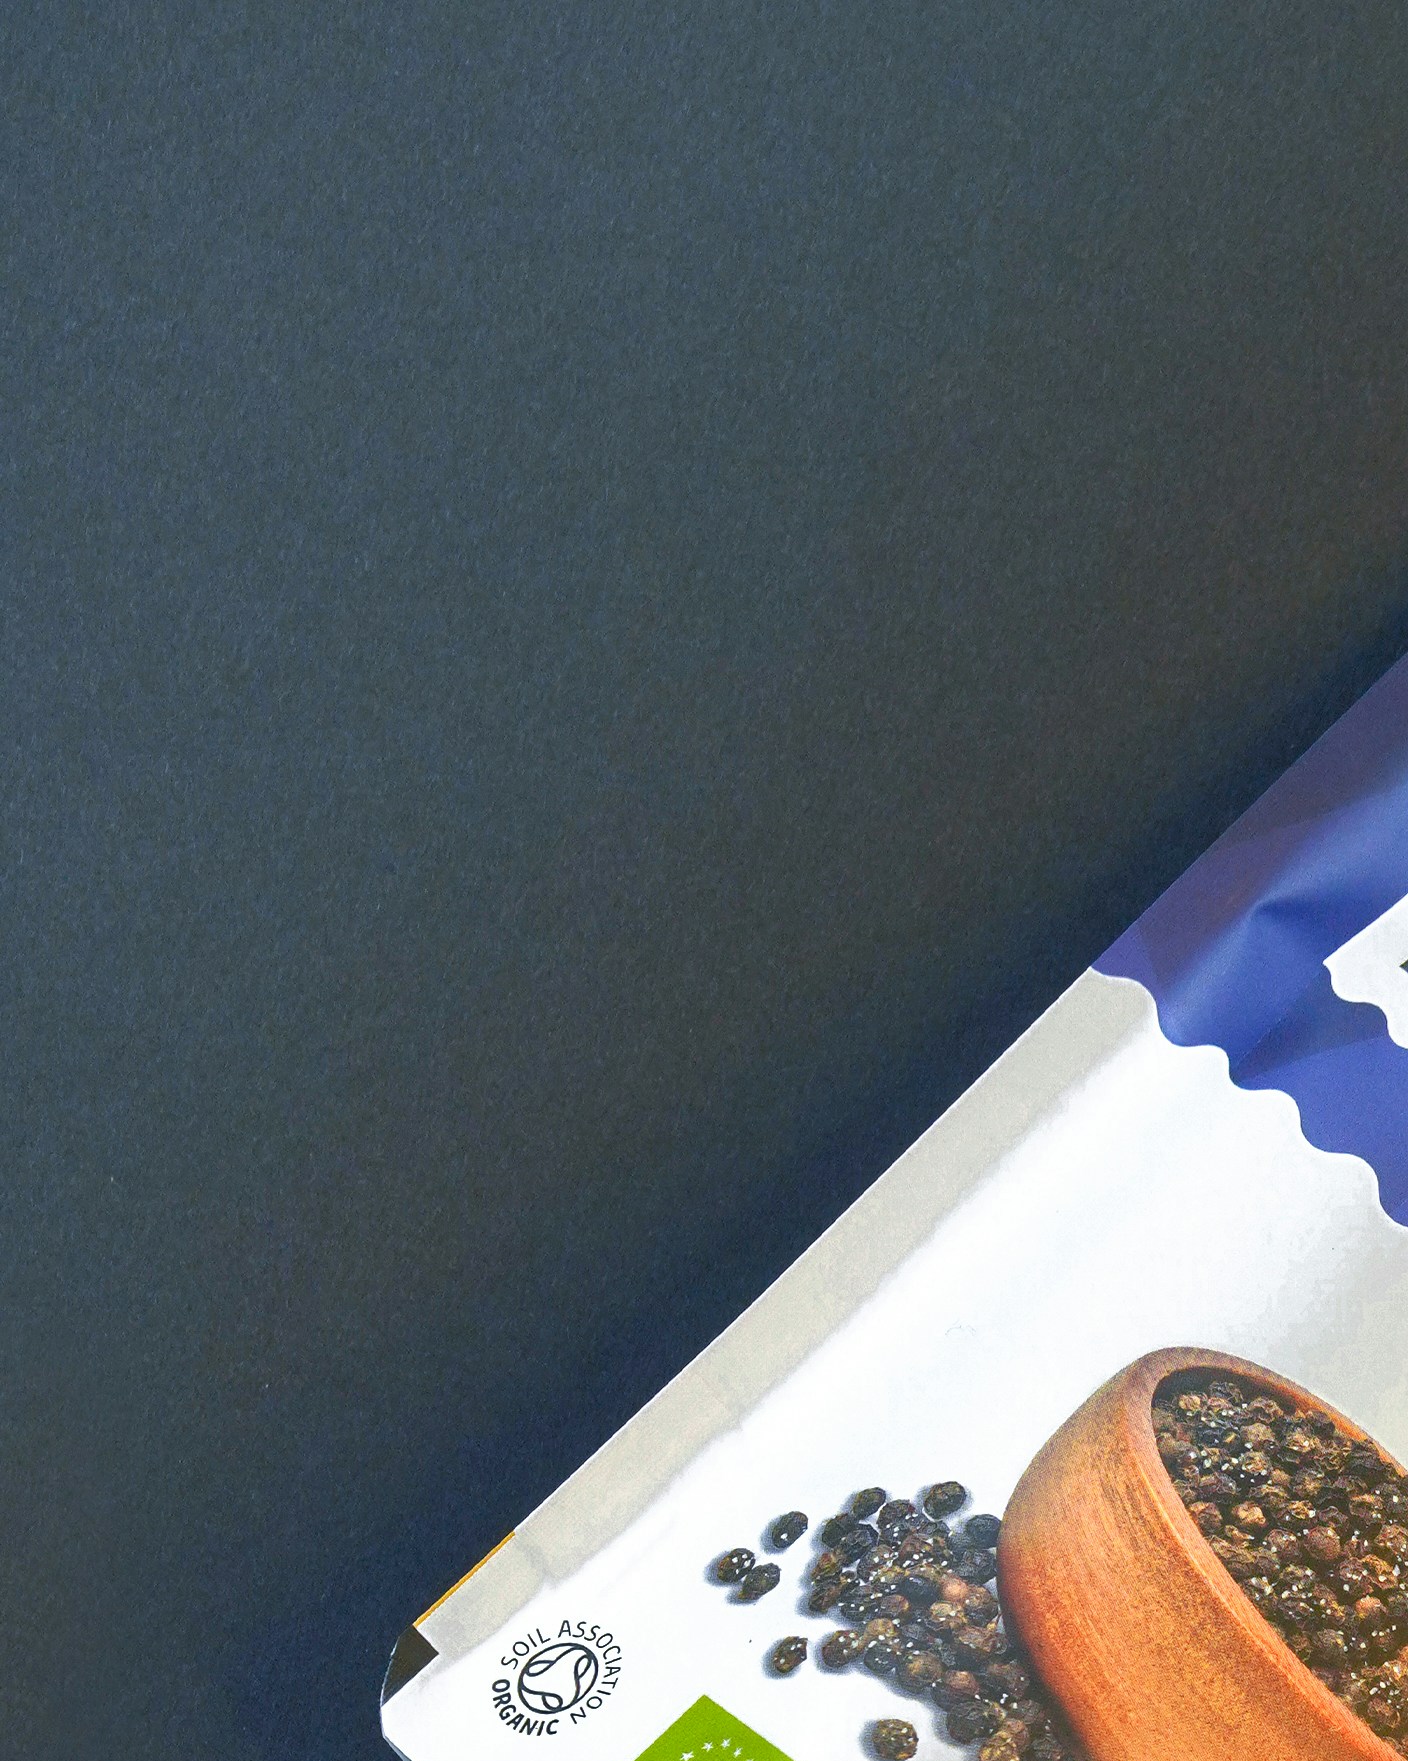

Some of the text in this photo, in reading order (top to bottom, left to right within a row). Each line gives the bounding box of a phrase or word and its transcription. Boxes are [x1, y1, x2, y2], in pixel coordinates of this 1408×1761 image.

[492, 1679, 559, 1736] ORGANIC
[501, 1620, 622, 1724] SOIL ASSOCIATION
